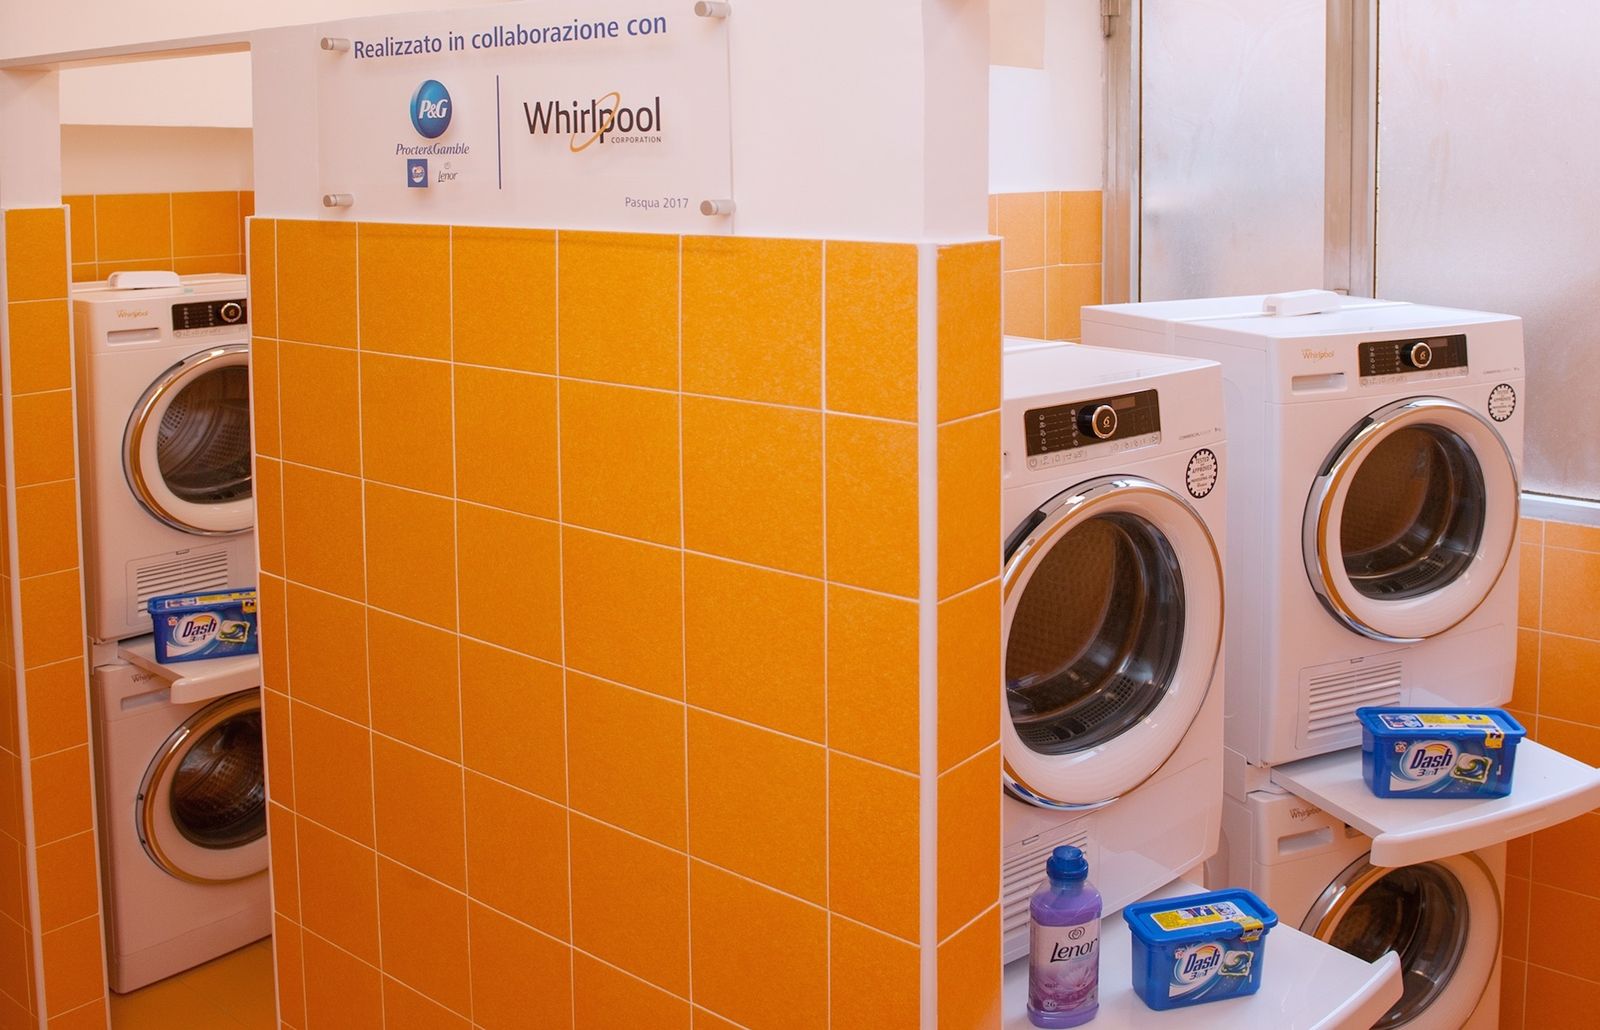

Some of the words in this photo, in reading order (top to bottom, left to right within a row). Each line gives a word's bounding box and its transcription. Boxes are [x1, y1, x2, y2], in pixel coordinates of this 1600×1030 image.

[354, 35, 442, 59] Realizzato
[449, 31, 464, 51] in
[472, 18, 619, 49] collaborazione
[627, 16, 666, 36] con
[418, 99, 449, 119] P&G
[523, 96, 661, 144] Whirlpool
[396, 142, 470, 156] Procter&Gamble
[611, 136, 662, 144] CORPORATION
[625, 197, 660, 210] Pasqua
[663, 197, 689, 208] 2017
[182, 618, 217, 638] Dash
[1409, 747, 1453, 770] Dash
[1050, 938, 1098, 963] Lenor
[1183, 947, 1221, 975] Dash
